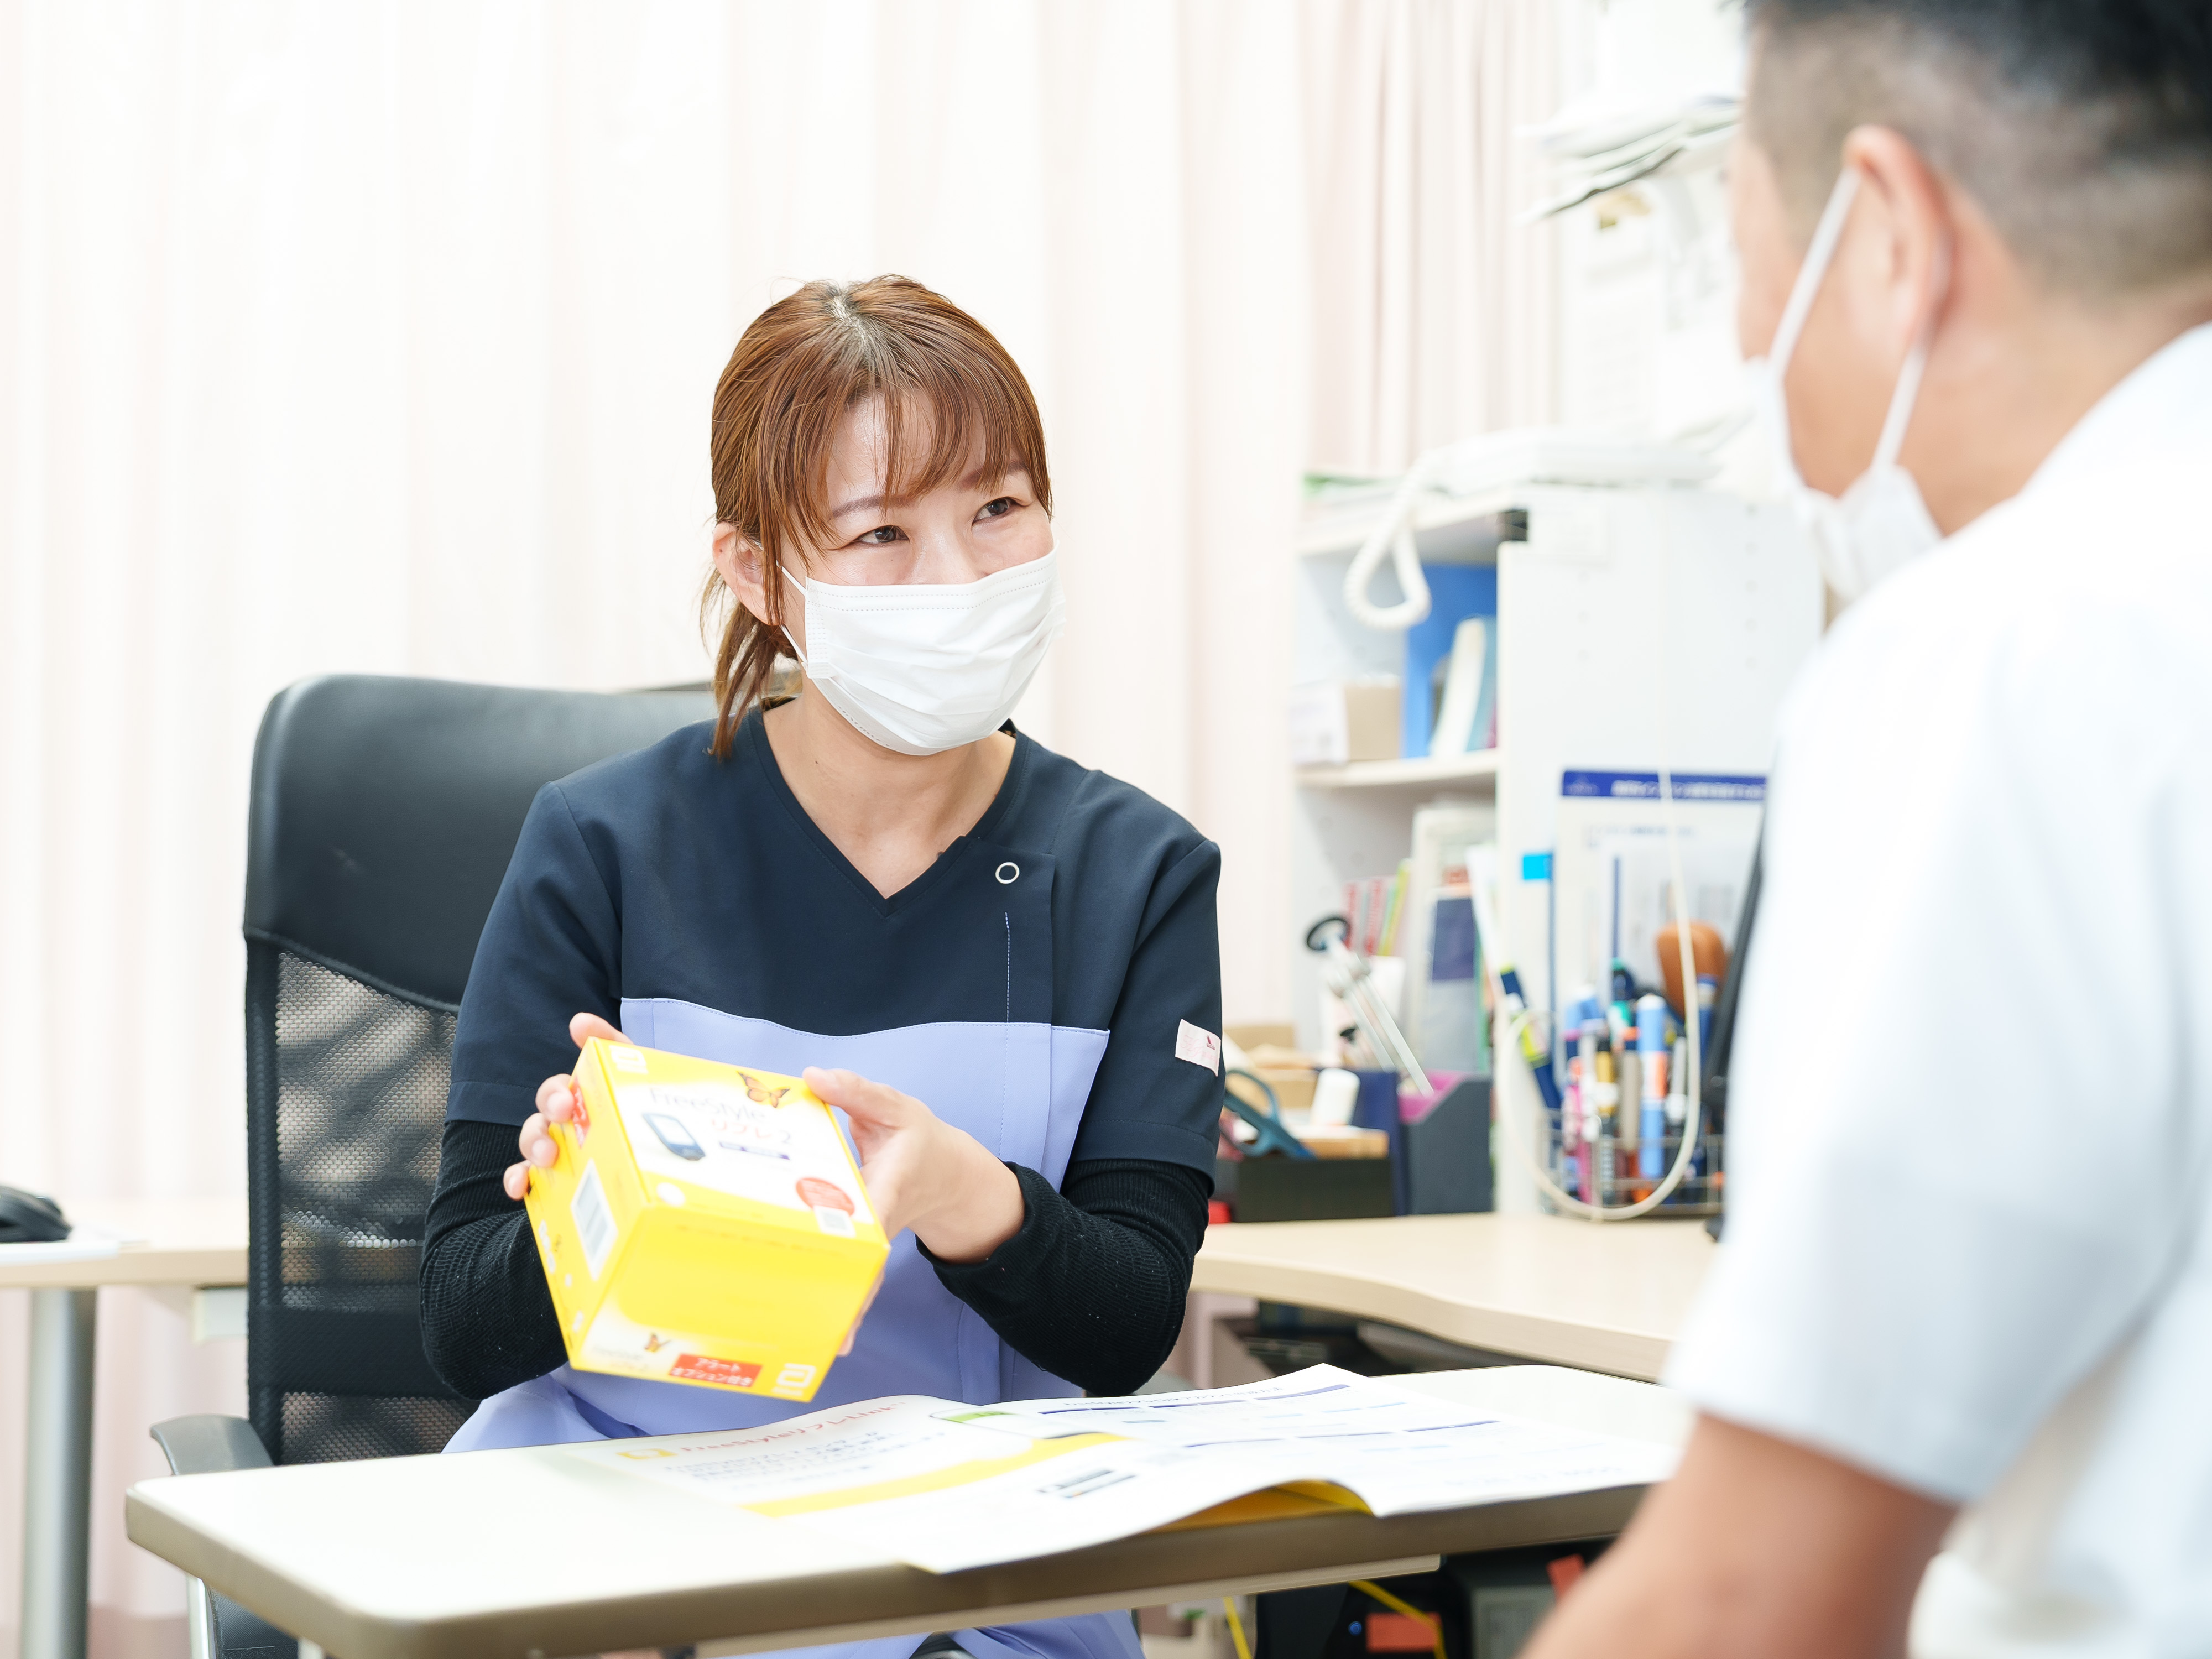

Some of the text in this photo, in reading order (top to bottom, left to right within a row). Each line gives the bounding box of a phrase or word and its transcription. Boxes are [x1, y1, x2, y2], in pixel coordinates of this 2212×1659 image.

[650, 1088, 766, 1121] FreeStyle
[696, 1358, 740, 1373] アラート
[672, 1368, 752, 1386] オプション付き
